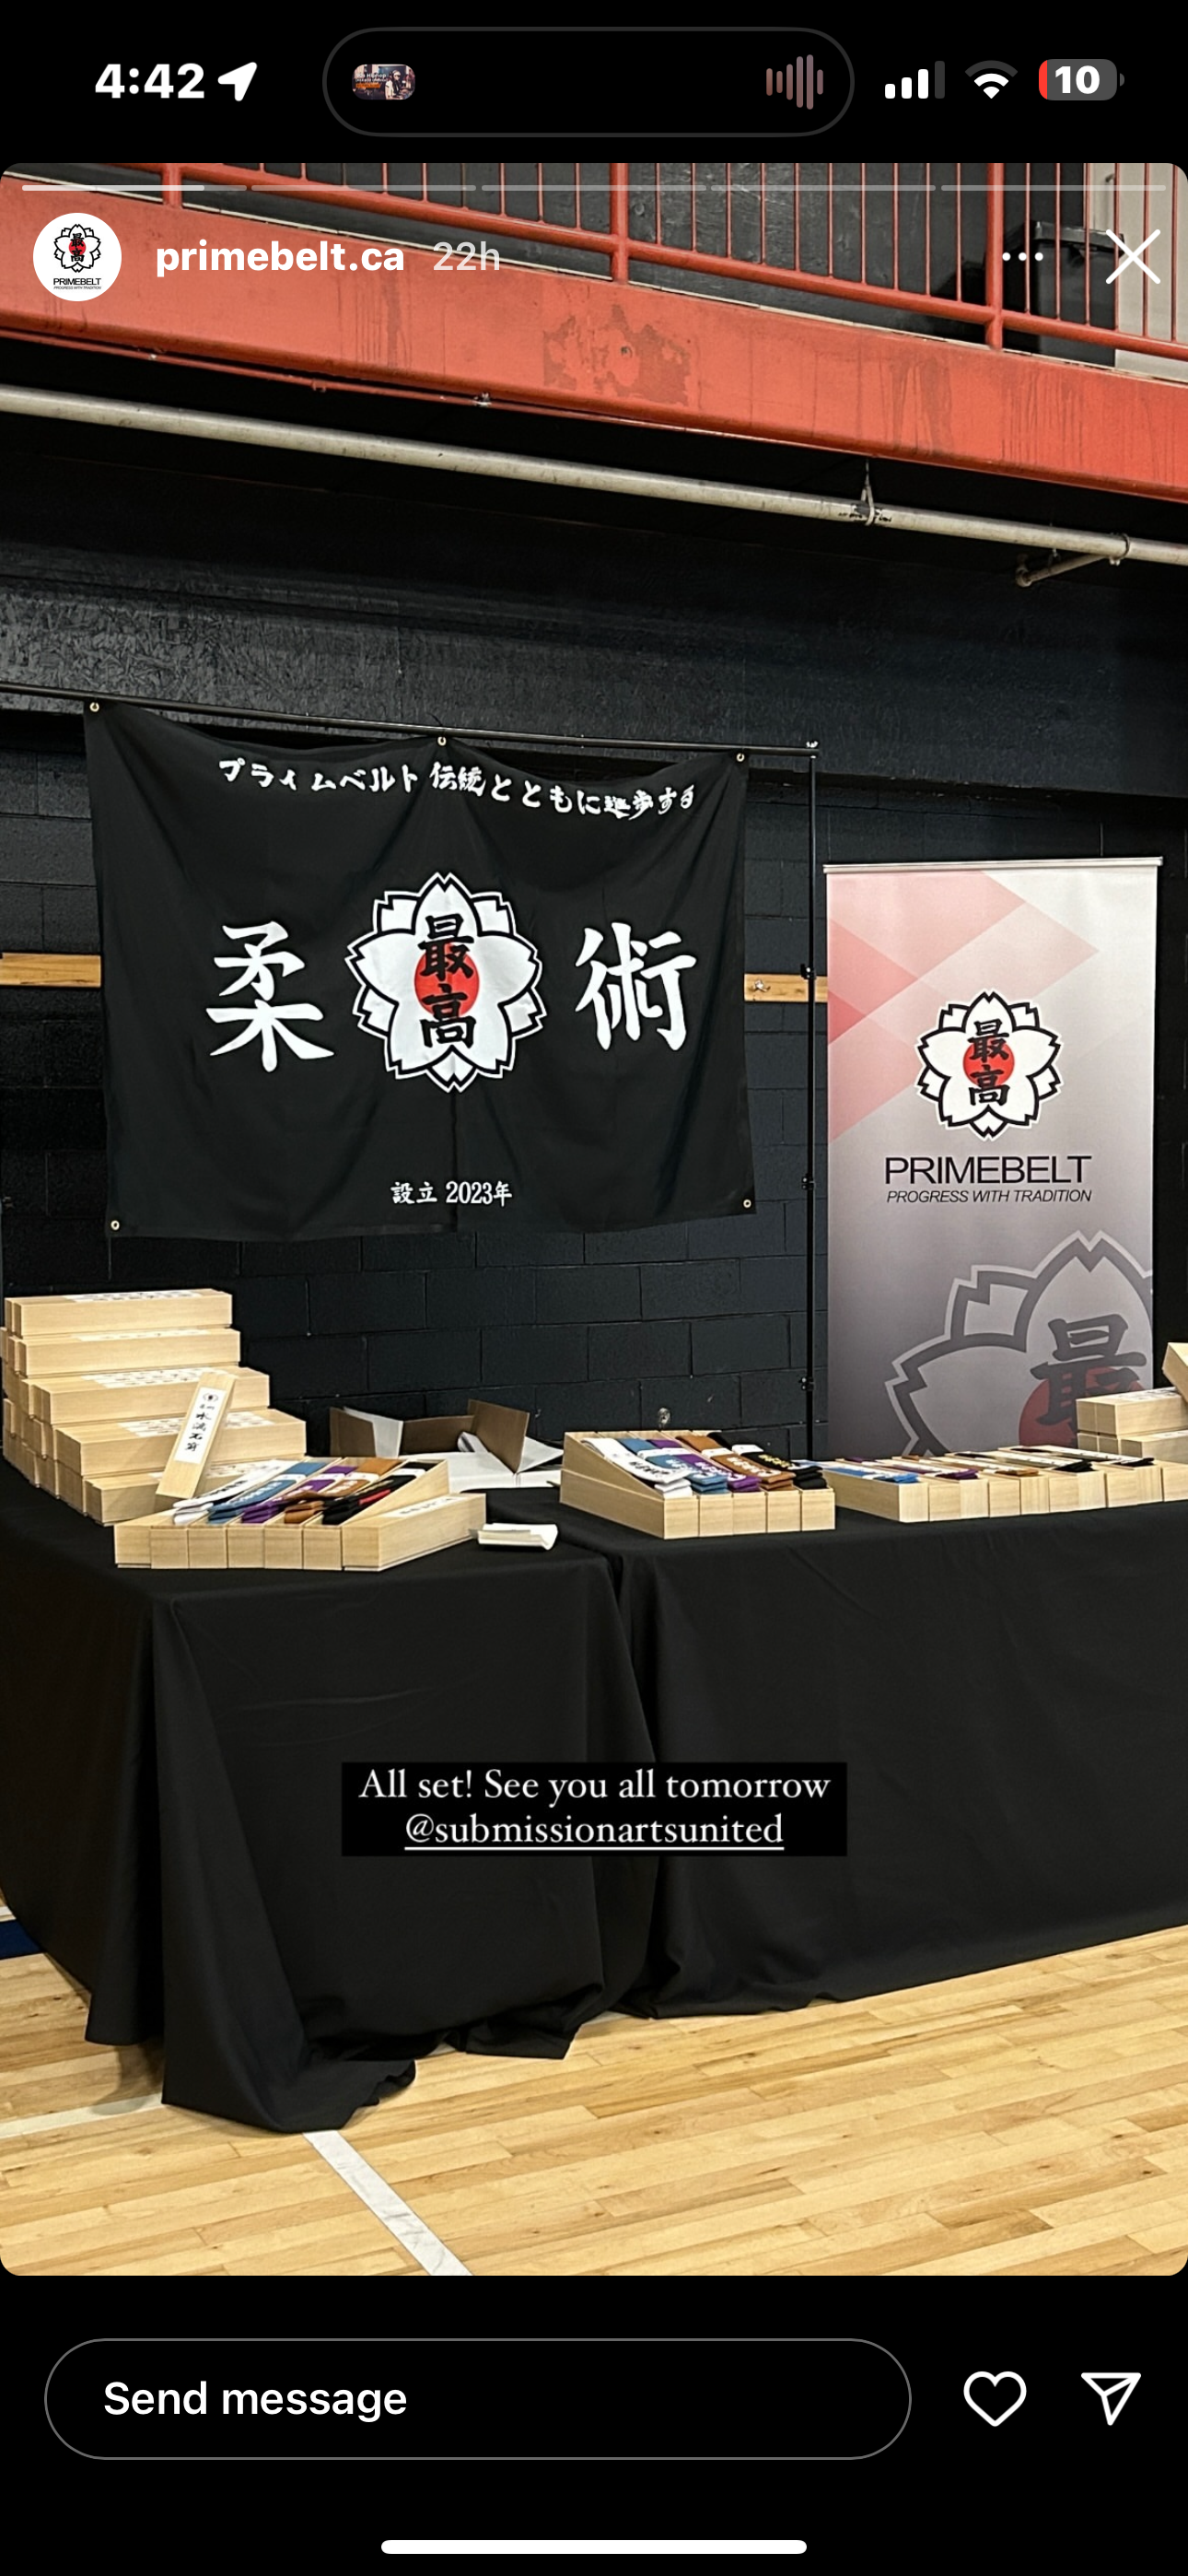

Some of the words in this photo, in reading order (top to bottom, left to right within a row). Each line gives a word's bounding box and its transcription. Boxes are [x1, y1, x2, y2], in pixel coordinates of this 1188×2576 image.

[218, 757, 418, 793] プライムベルト
[429, 761, 694, 820] 伝統とともに進歩する
[205, 920, 334, 1072] 柔
[575, 922, 697, 1051] 術
[417, 913, 477, 1048] 最高
[967, 1018, 1010, 1107] 最高
[390, 1181, 438, 1204] 設立
[445, 1180, 513, 1207] 2023年
[885, 1155, 1092, 1185] PRIMEBELT
[887, 1190, 969, 1203] PROGRESS
[973, 1190, 1010, 1202] WITH
[1014, 1189, 1092, 1202] TRADITION
